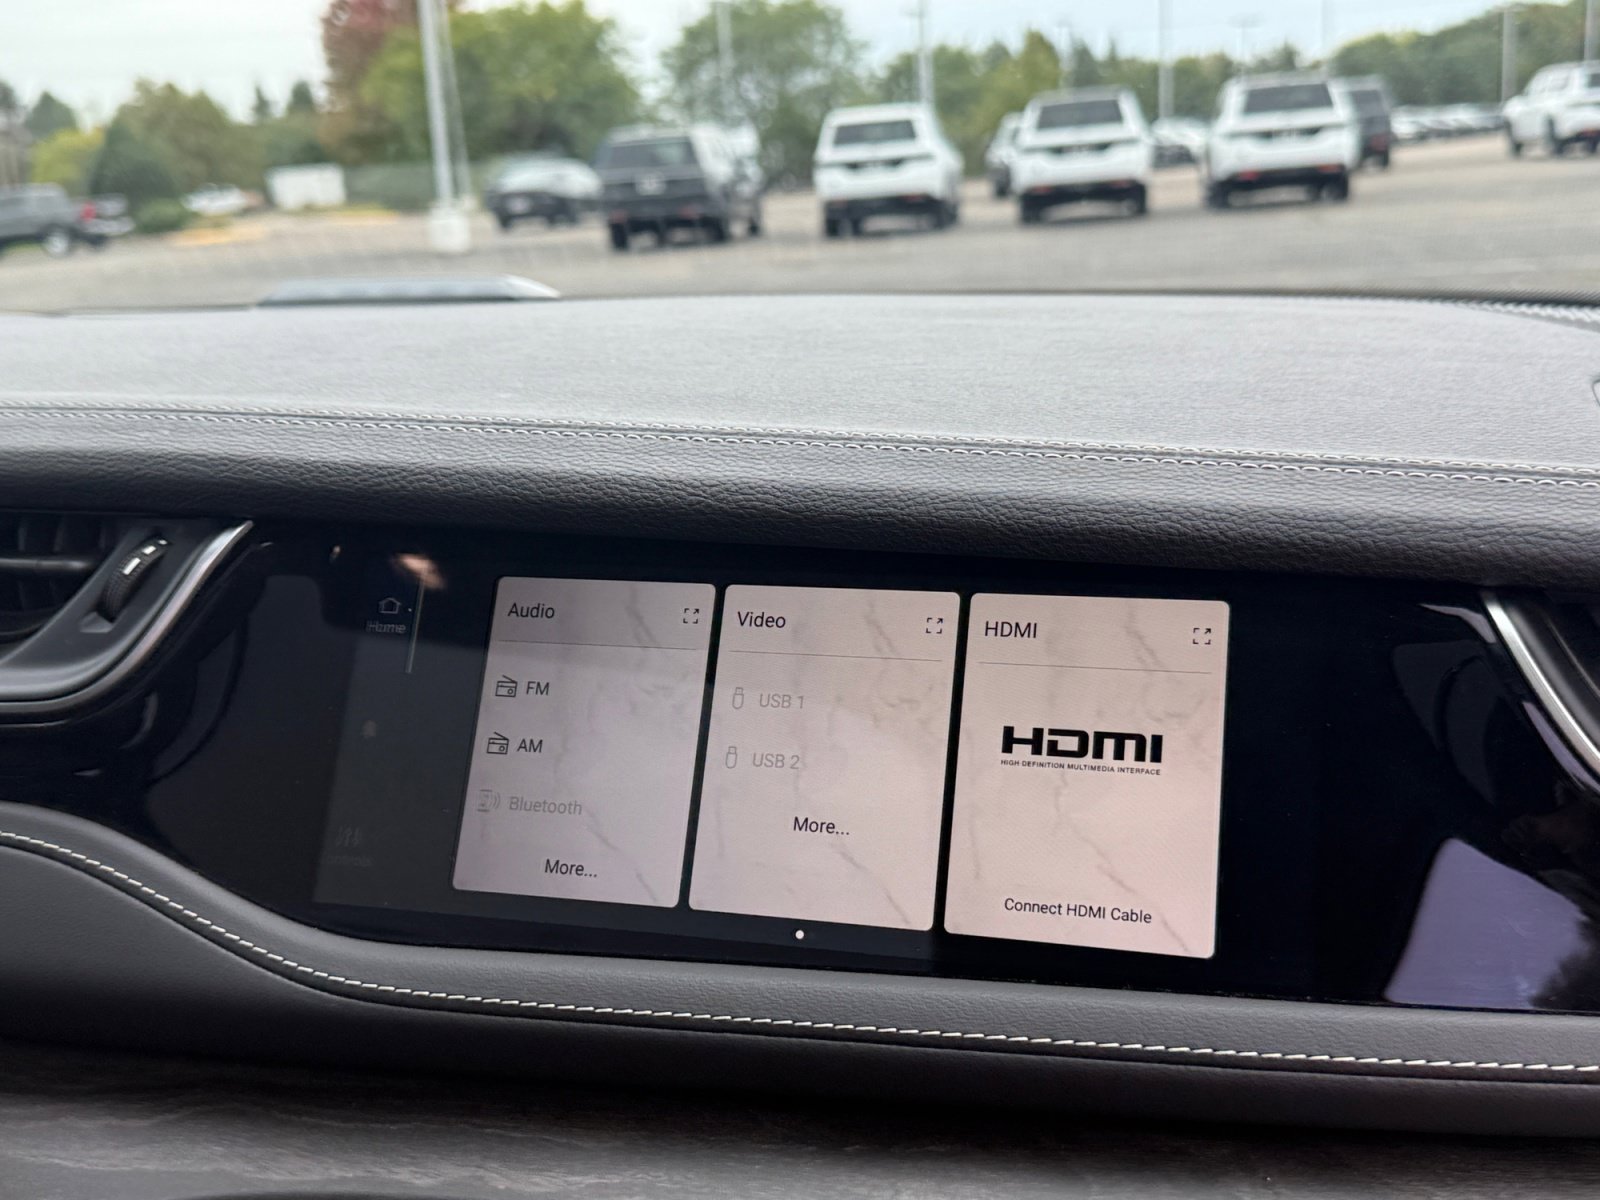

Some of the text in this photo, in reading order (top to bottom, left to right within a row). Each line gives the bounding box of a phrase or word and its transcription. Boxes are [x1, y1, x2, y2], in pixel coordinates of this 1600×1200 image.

[507, 602, 556, 621] Audio
[737, 611, 787, 629] Video
[984, 621, 1038, 638] HDMI
[525, 681, 550, 697] FM
[758, 693, 804, 709] USB 1
[516, 739, 543, 754] AM
[1001, 725, 1163, 763] HDMI
[752, 752, 801, 770] USB 2
[1000, 759, 1161, 776] HIGH DEFINITION MULTIMEDIA INTERFACE
[509, 796, 583, 816] Bluetooth
[793, 816, 850, 836] More...
[544, 859, 598, 879] More...
[1004, 897, 1152, 924] Connect HDMI Cable
